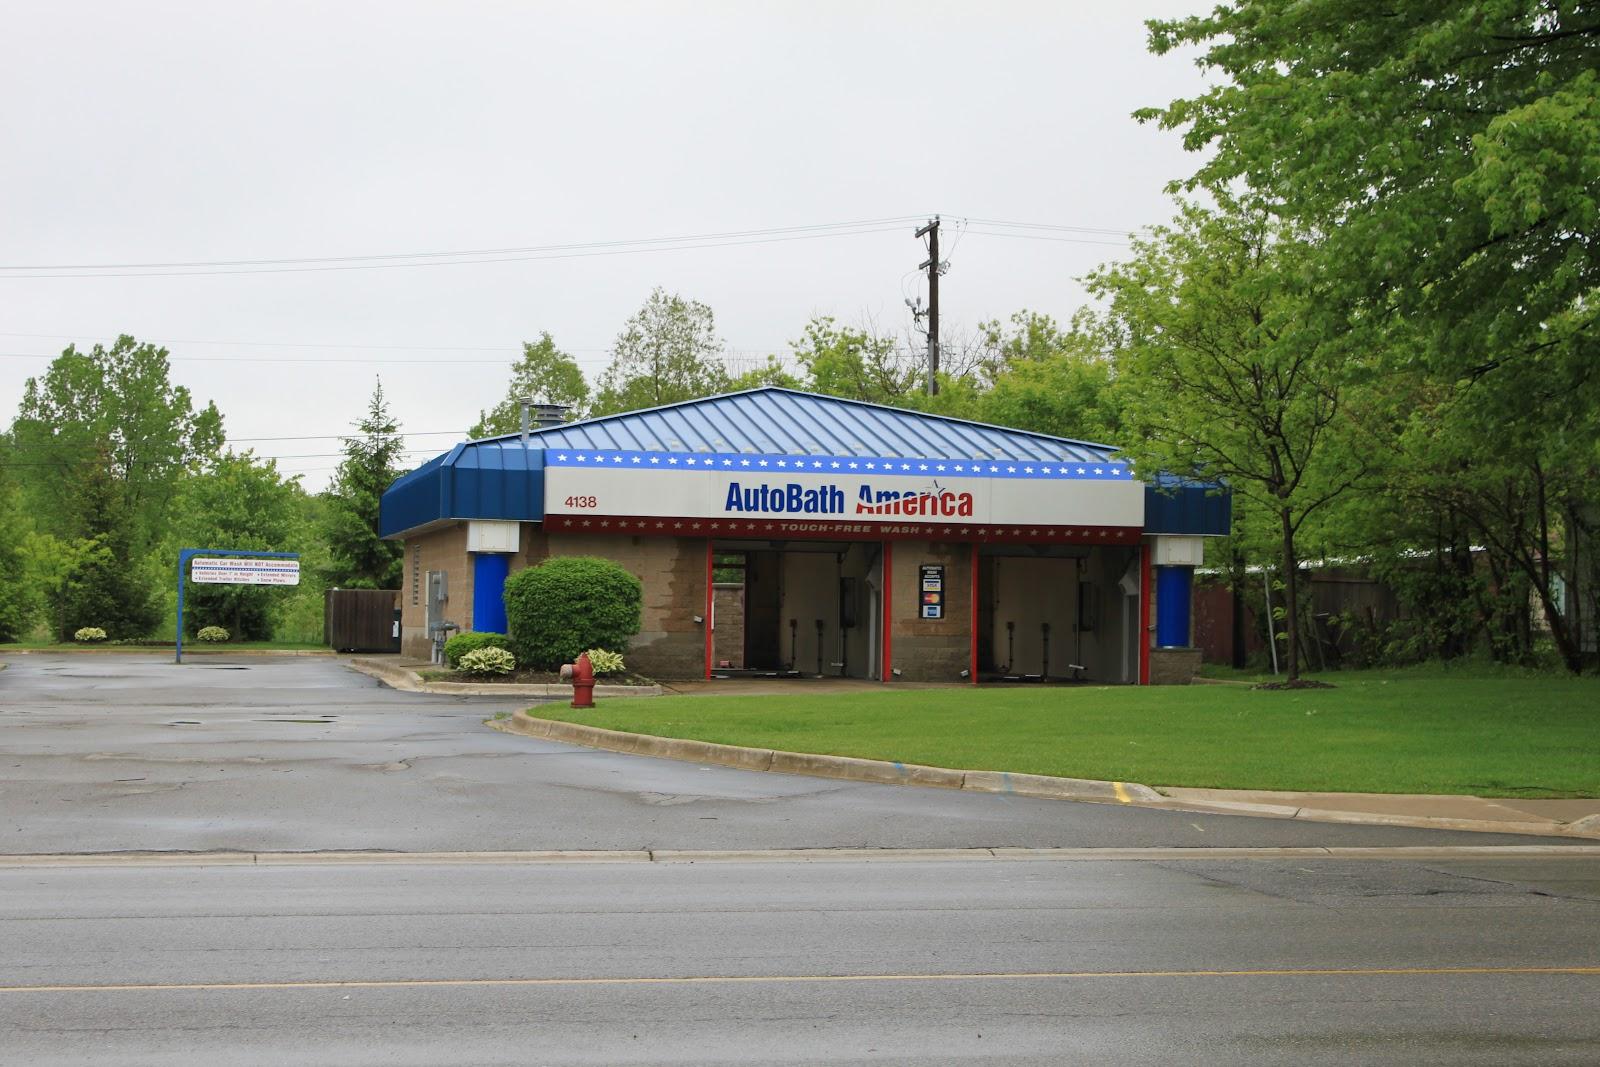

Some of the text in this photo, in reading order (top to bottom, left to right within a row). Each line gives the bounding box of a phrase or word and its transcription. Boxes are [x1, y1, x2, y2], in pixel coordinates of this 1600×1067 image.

[565, 496, 597, 508] 4138
[725, 482, 973, 517] AutoBath America
[781, 523, 919, 534] TOUCH-FREE WASH
